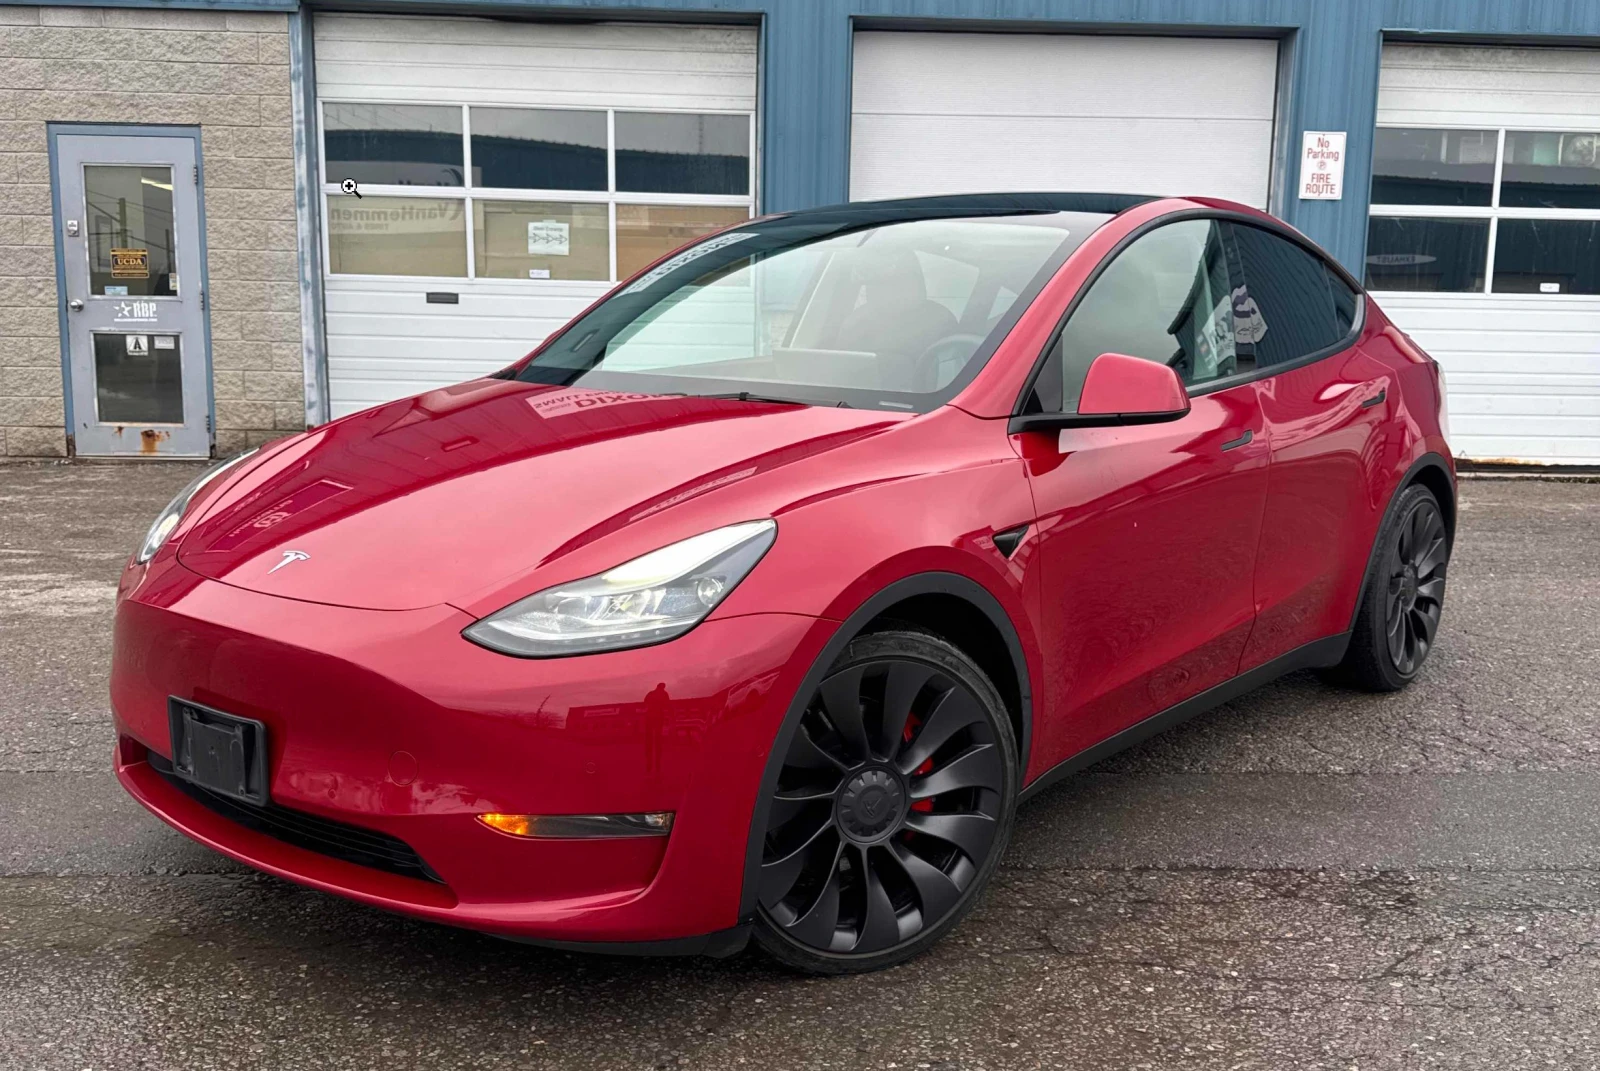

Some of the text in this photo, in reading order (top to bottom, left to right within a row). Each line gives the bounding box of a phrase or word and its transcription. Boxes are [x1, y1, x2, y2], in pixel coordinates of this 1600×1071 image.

[1317, 137, 1330, 148] No
[1306, 147, 1339, 162] Parking
[1311, 173, 1331, 183] FIRE
[1305, 183, 1336, 195] ROUTE
